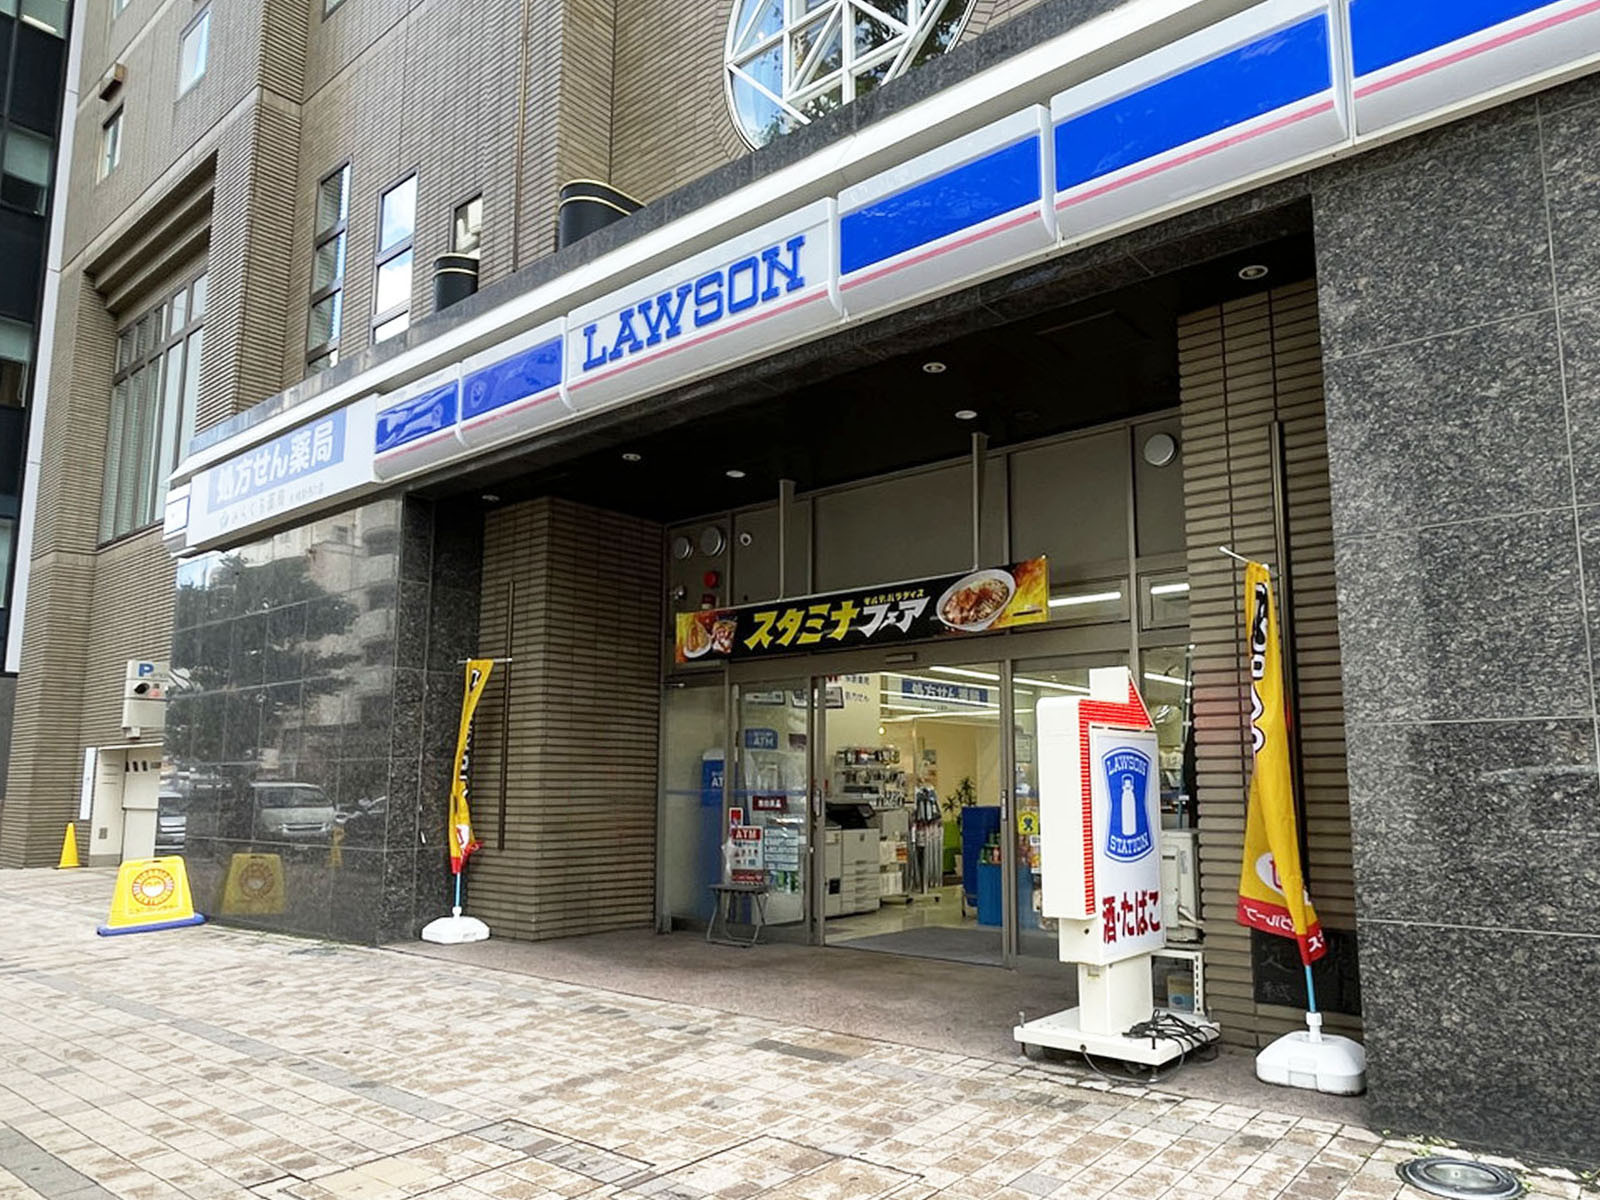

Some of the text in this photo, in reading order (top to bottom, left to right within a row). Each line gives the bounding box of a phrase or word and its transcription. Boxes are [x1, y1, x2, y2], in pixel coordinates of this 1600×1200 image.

[582, 234, 806, 372] LAWSON
[216, 420, 334, 504] 処方せん薬局
[743, 596, 932, 650] スタミナフェア
[138, 662, 154, 678] P
[752, 737, 774, 747] ATM
[1106, 754, 1150, 776] LAWSON
[735, 829, 758, 840] ATM
[1109, 832, 1150, 855] STATION
